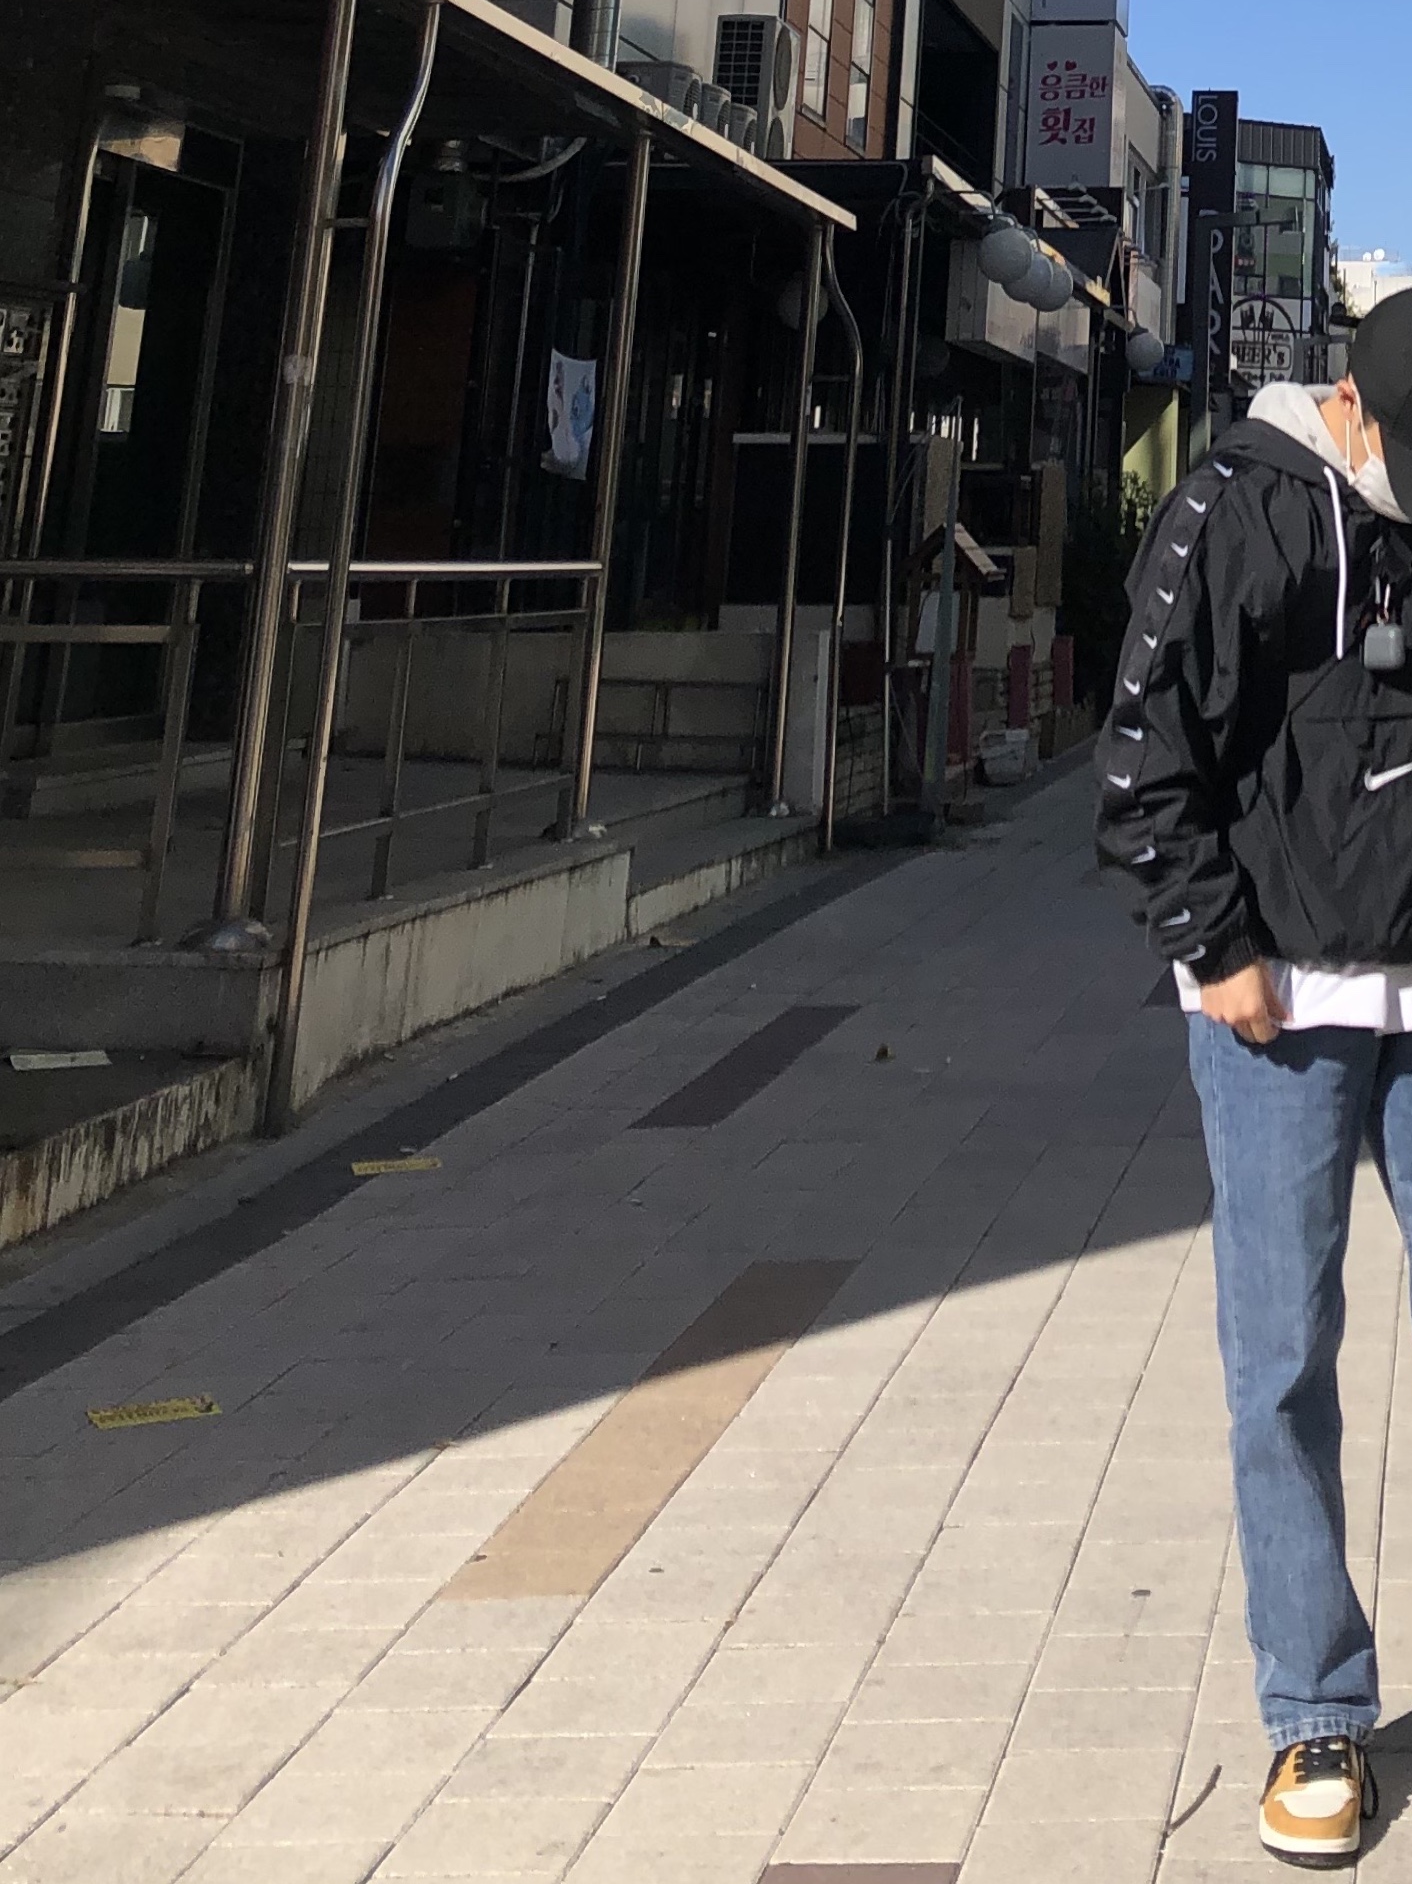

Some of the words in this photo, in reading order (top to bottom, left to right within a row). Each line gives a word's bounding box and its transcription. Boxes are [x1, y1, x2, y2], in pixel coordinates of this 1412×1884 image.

[1039, 73, 1108, 102] 응큼한
[1038, 106, 1096, 146] 횟집
[1196, 95, 1218, 163] LOUIS
